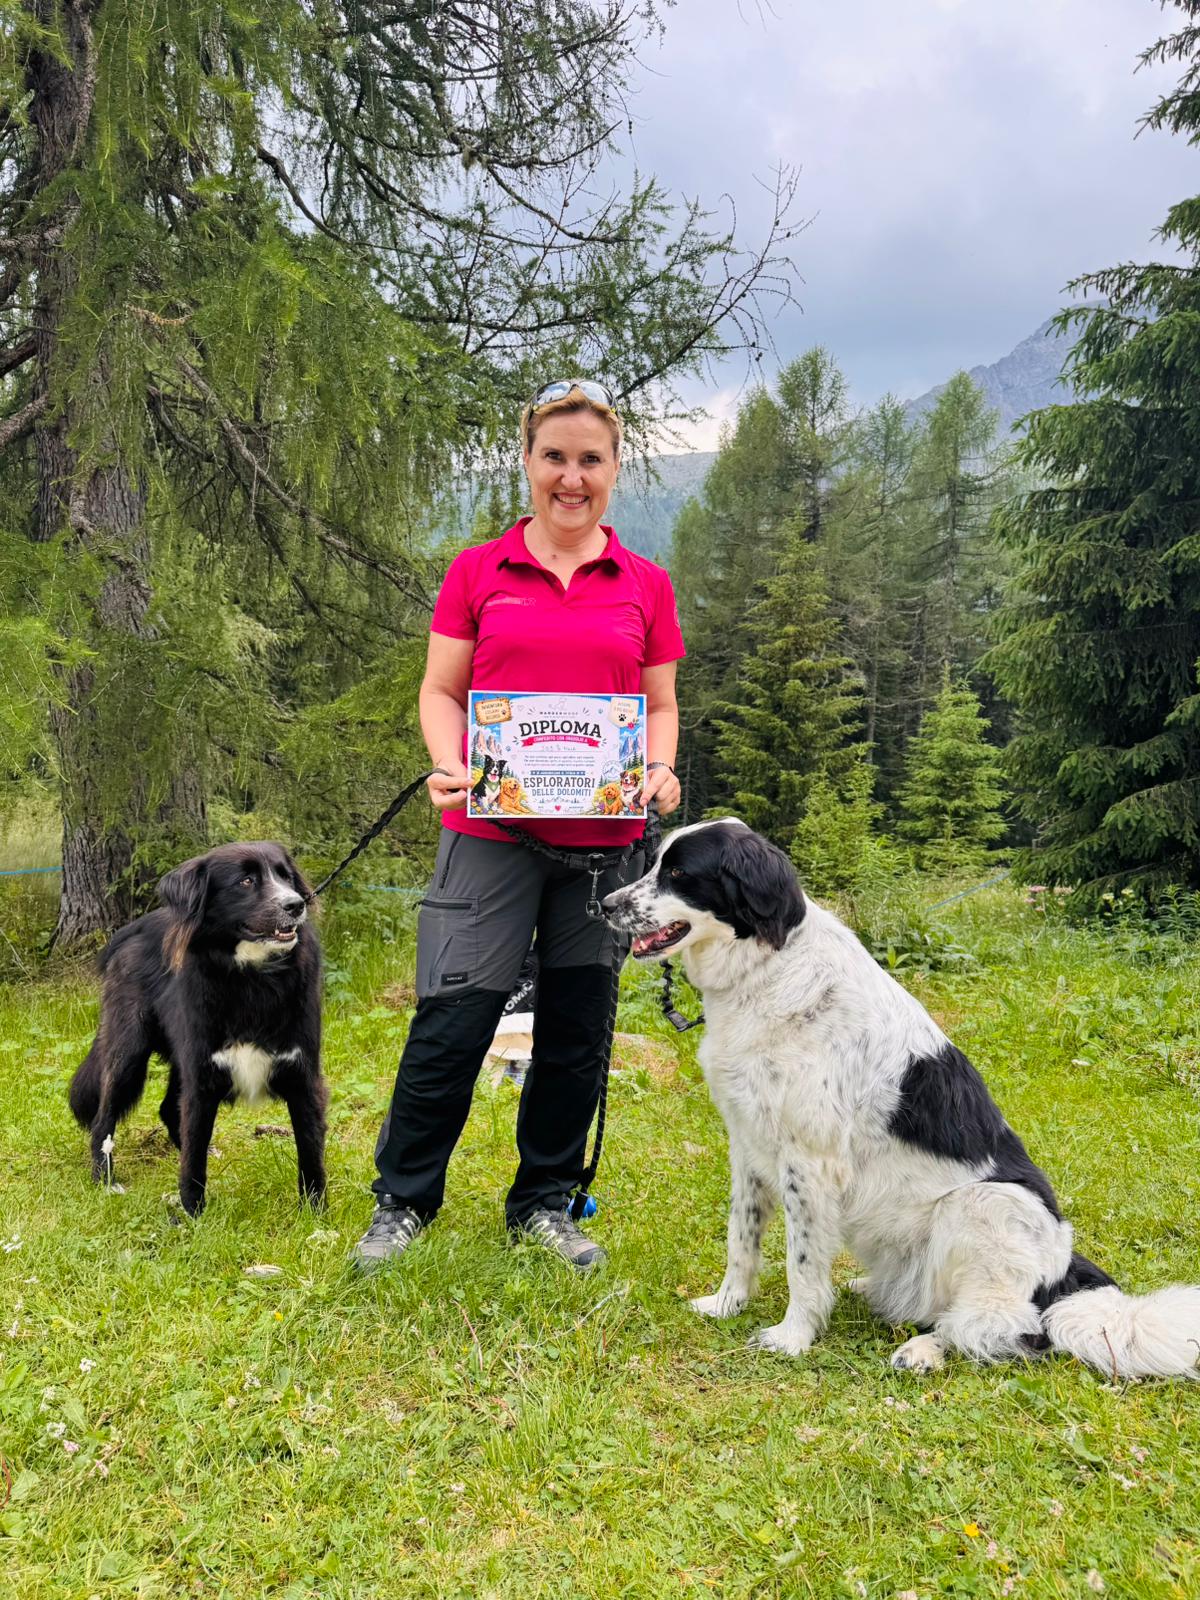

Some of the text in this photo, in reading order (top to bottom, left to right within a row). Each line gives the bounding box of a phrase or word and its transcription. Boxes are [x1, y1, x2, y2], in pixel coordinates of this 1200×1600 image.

[519, 719, 602, 738] DIPLOMA
[523, 776, 595, 788] ESPLORATORI
[532, 788, 591, 797] DELLE DOLOMITI
